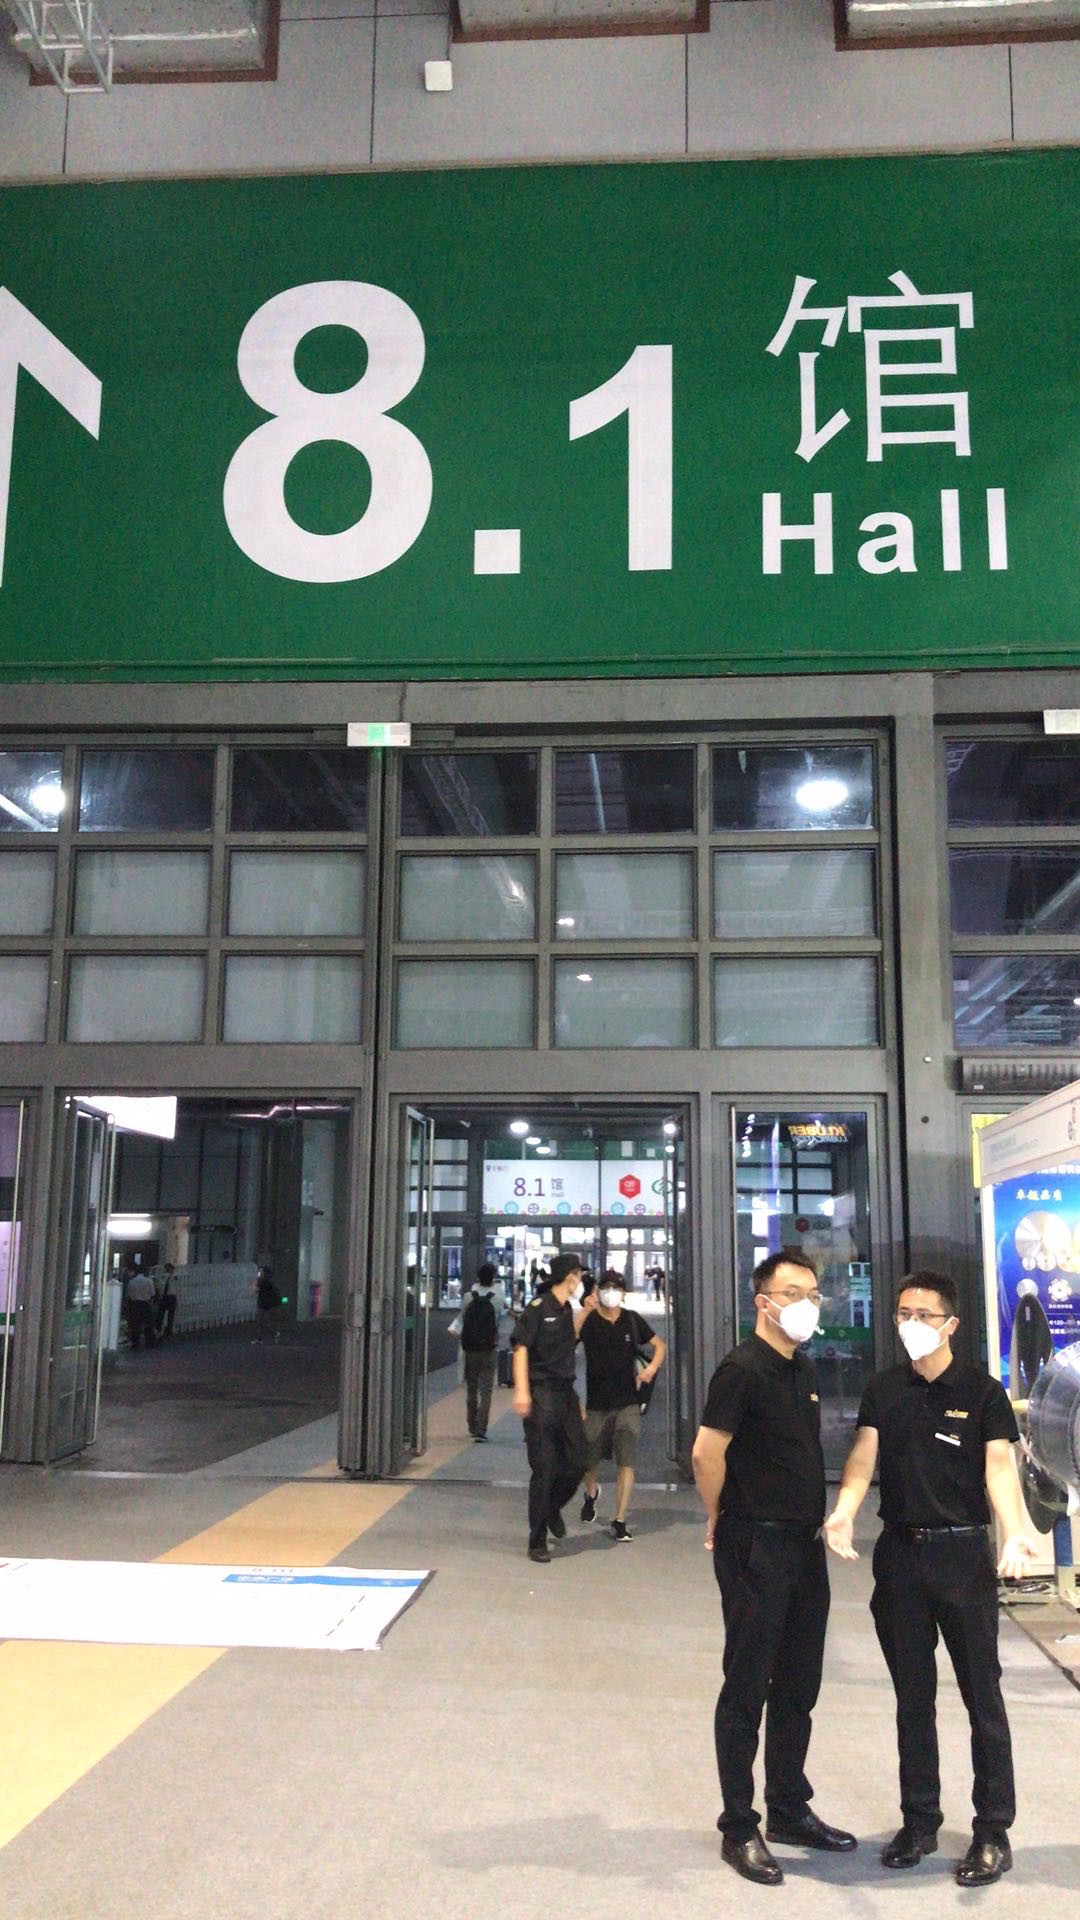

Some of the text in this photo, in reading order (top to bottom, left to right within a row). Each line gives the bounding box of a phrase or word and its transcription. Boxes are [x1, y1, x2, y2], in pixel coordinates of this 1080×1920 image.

[223, 280, 673, 584] 8.1
[765, 270, 975, 463] 馆
[762, 487, 1009, 575] Hall
[513, 1177, 545, 1197] 8.1
